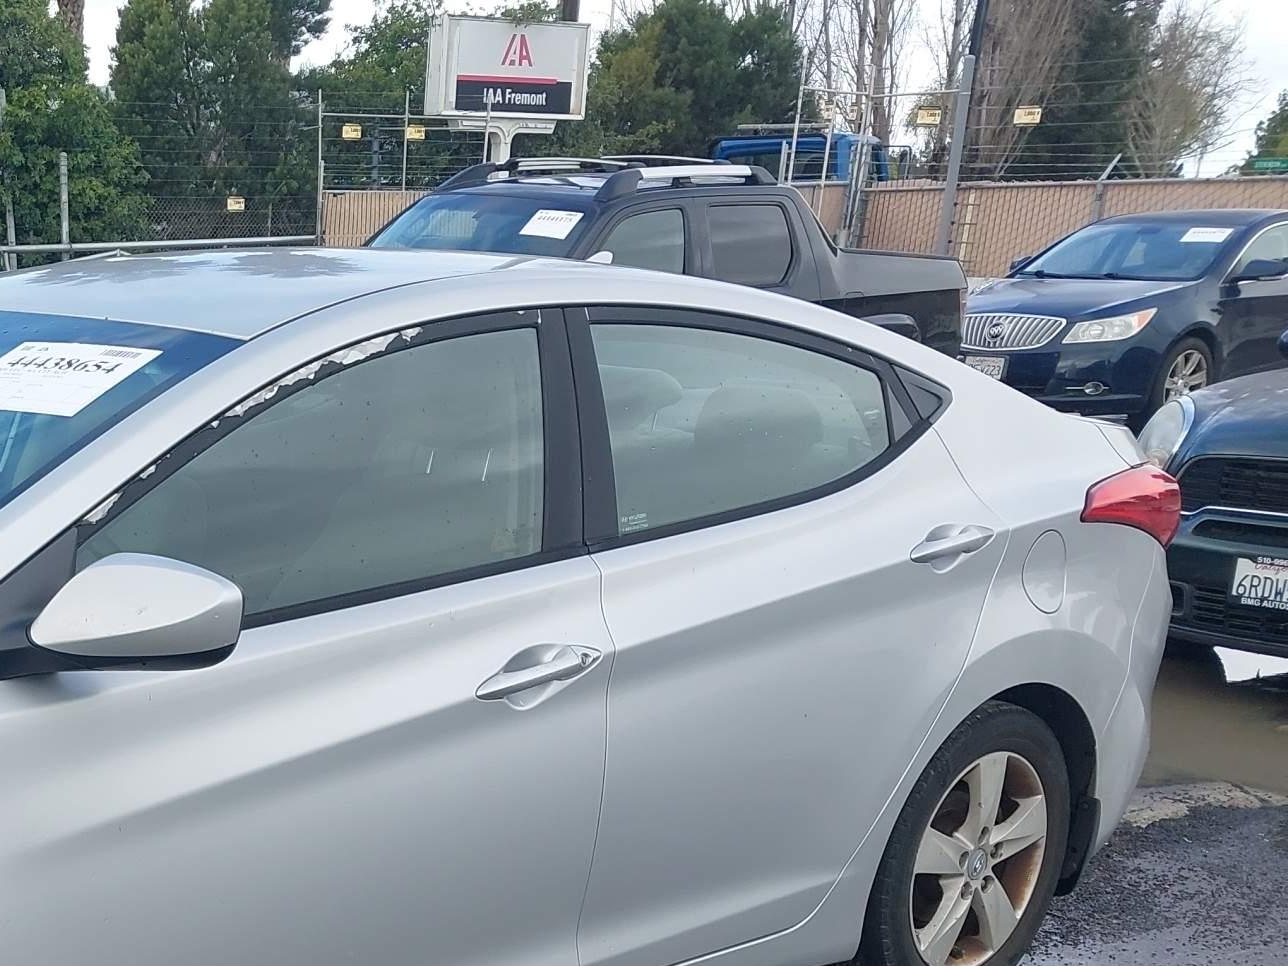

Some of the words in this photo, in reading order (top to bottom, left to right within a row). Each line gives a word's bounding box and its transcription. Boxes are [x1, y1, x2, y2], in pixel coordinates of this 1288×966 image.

[483, 87, 503, 104] IAA
[505, 88, 547, 106] Fremont
[8, 356, 123, 374] 44438654
[1236, 574, 1288, 601] 6RDW
[1241, 597, 1261, 606] BMG
